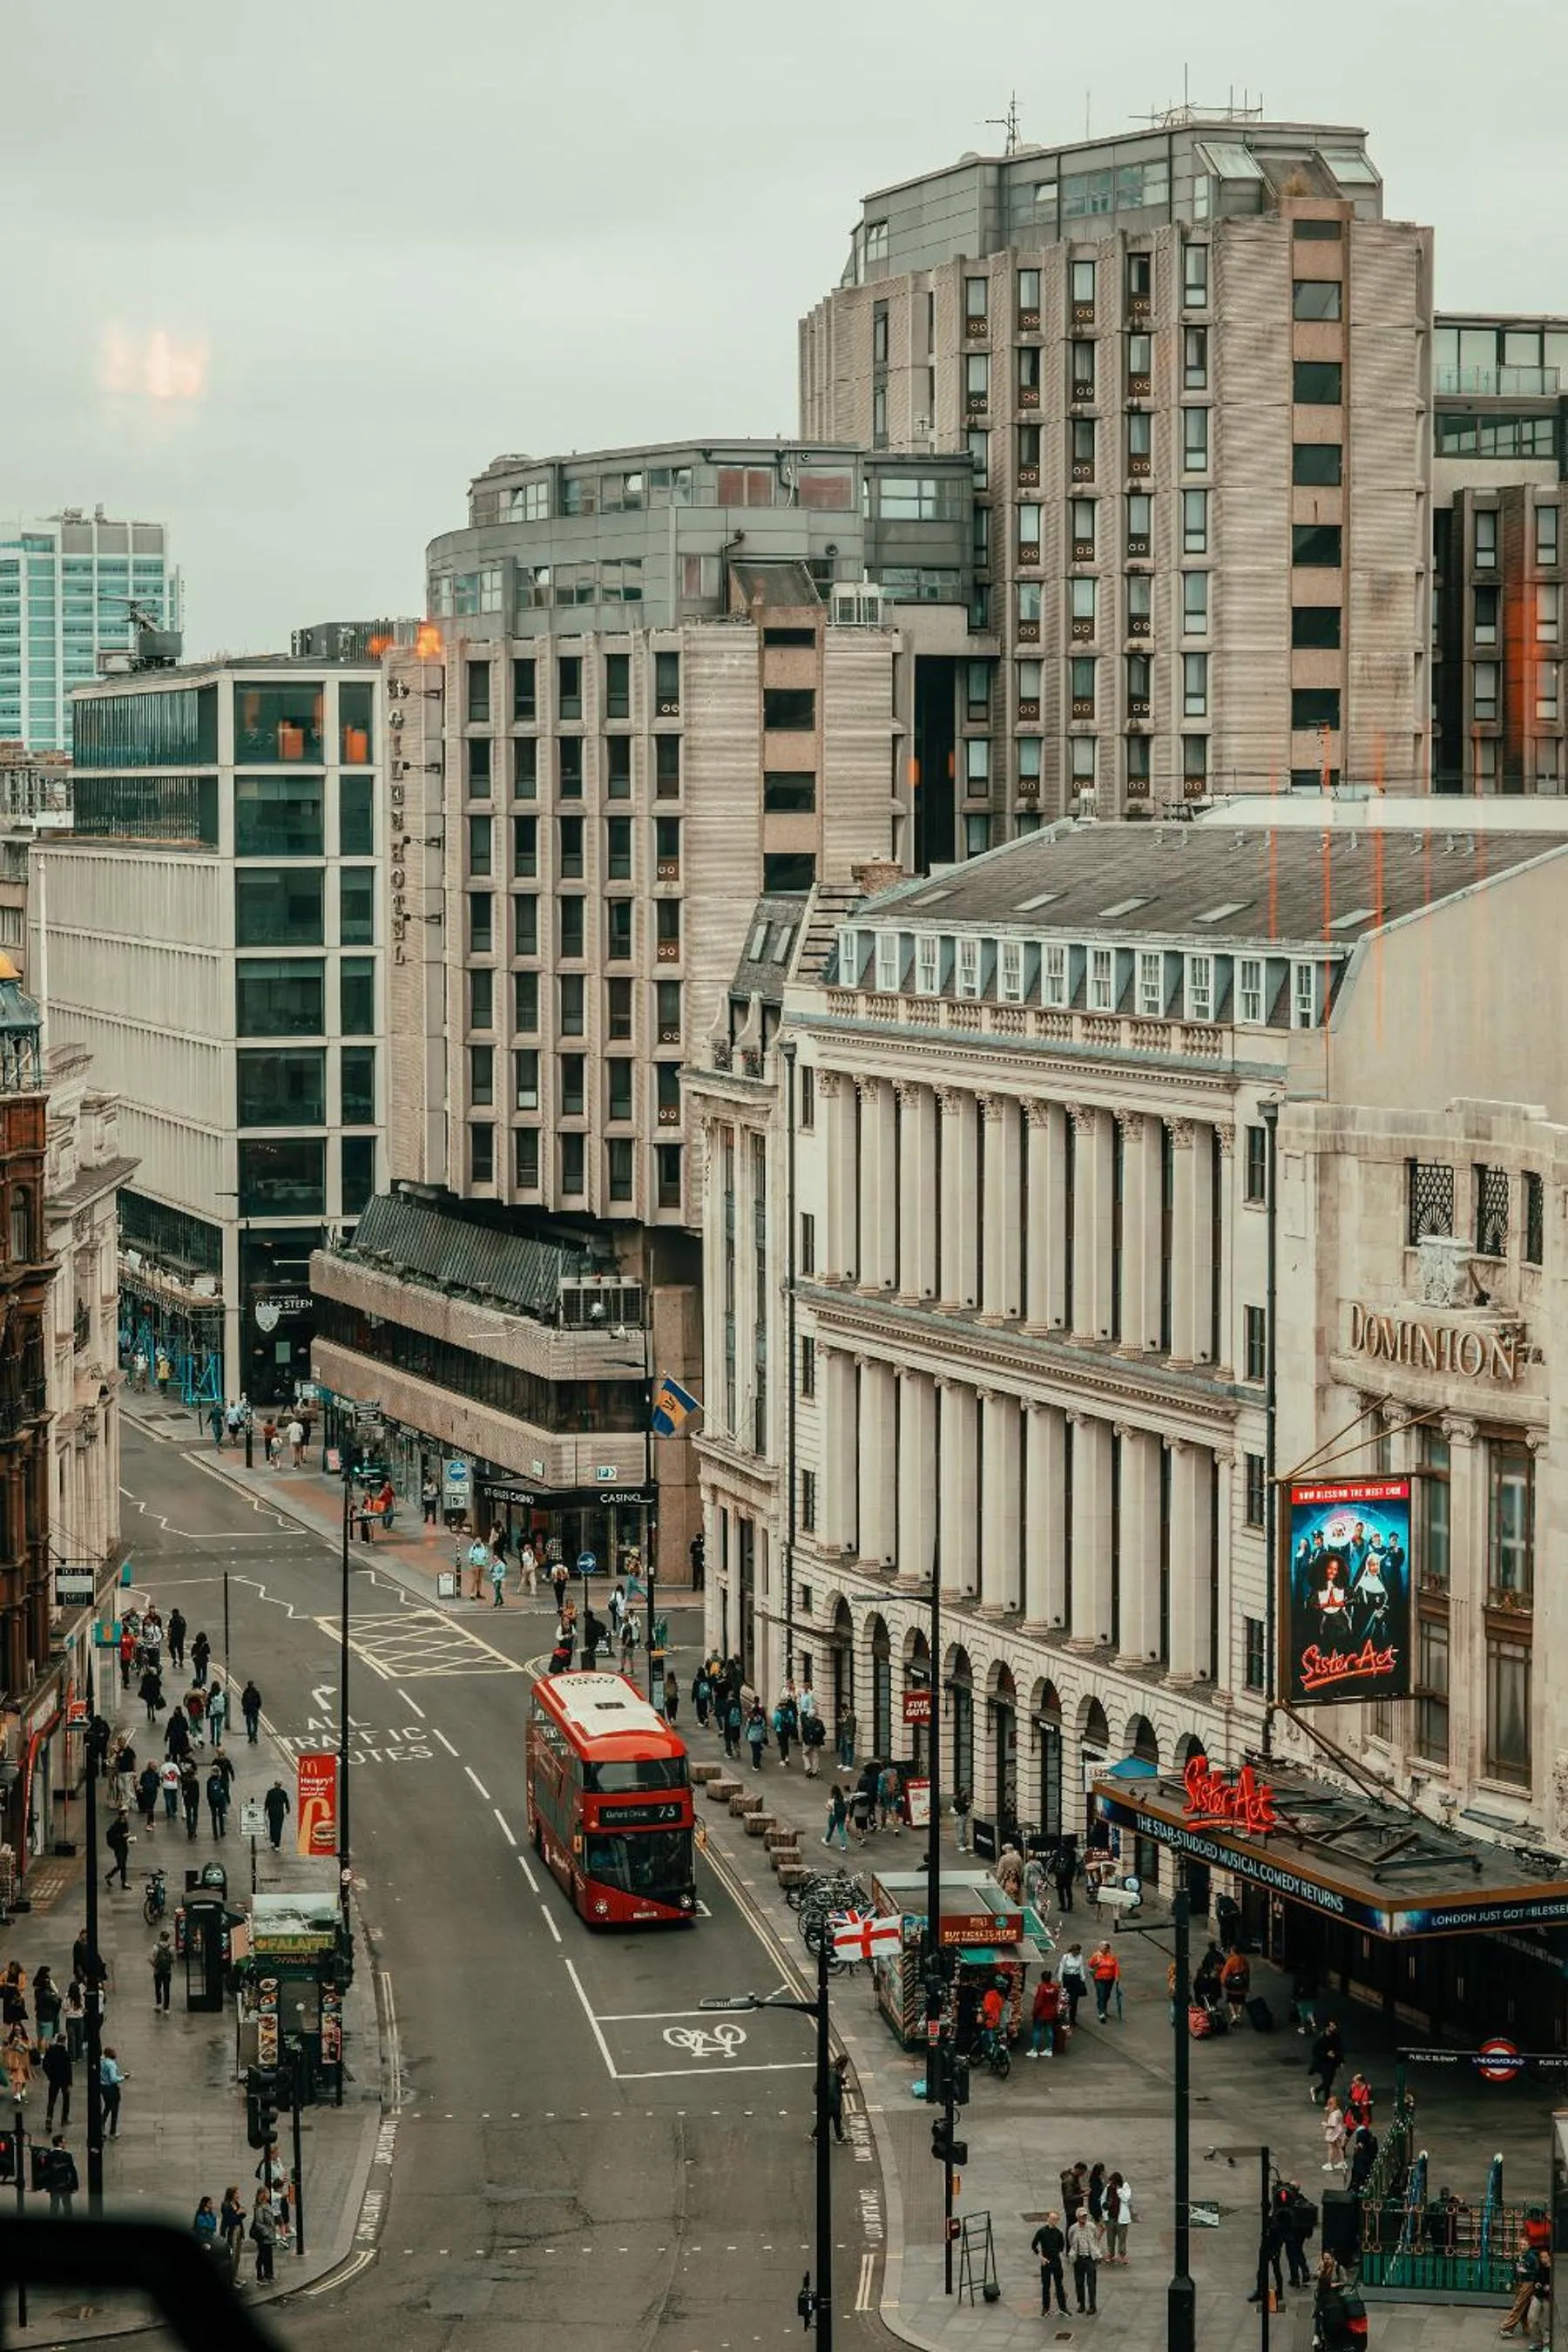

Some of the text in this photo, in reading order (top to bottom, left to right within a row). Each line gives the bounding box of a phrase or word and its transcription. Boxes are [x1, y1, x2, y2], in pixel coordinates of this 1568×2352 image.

[285, 1299, 313, 1308] STEEN
[1349, 1302, 1517, 1381] DOMINION
[510, 1491, 534, 1504] CASINO
[600, 1493, 641, 1504] CASINO
[1316, 1490, 1348, 1499] BLESSING
[1350, 1489, 1363, 1497] THE
[1365, 1487, 1383, 1497] WEST
[1386, 1486, 1401, 1496] END
[1300, 1639, 1400, 1686] Sister Act
[909, 1700, 929, 1709] FIVE
[906, 1707, 931, 1716] GUYS
[307, 1715, 373, 1731] ALL
[1182, 1755, 1278, 1834] Sister Act
[659, 1805, 676, 1818] 73
[1136, 1813, 1344, 1914] THE STAR-STUDDED MUSICAL COMEDY RETURNS
[1431, 1911, 1477, 1926] LONDON
[1478, 1910, 1500, 1923] JUST
[1503, 1908, 1524, 1919] GOT
[944, 1929, 1017, 1939] BUY TICKETS HERE
[1472, 2056, 1525, 2066] UNDERGROUND
